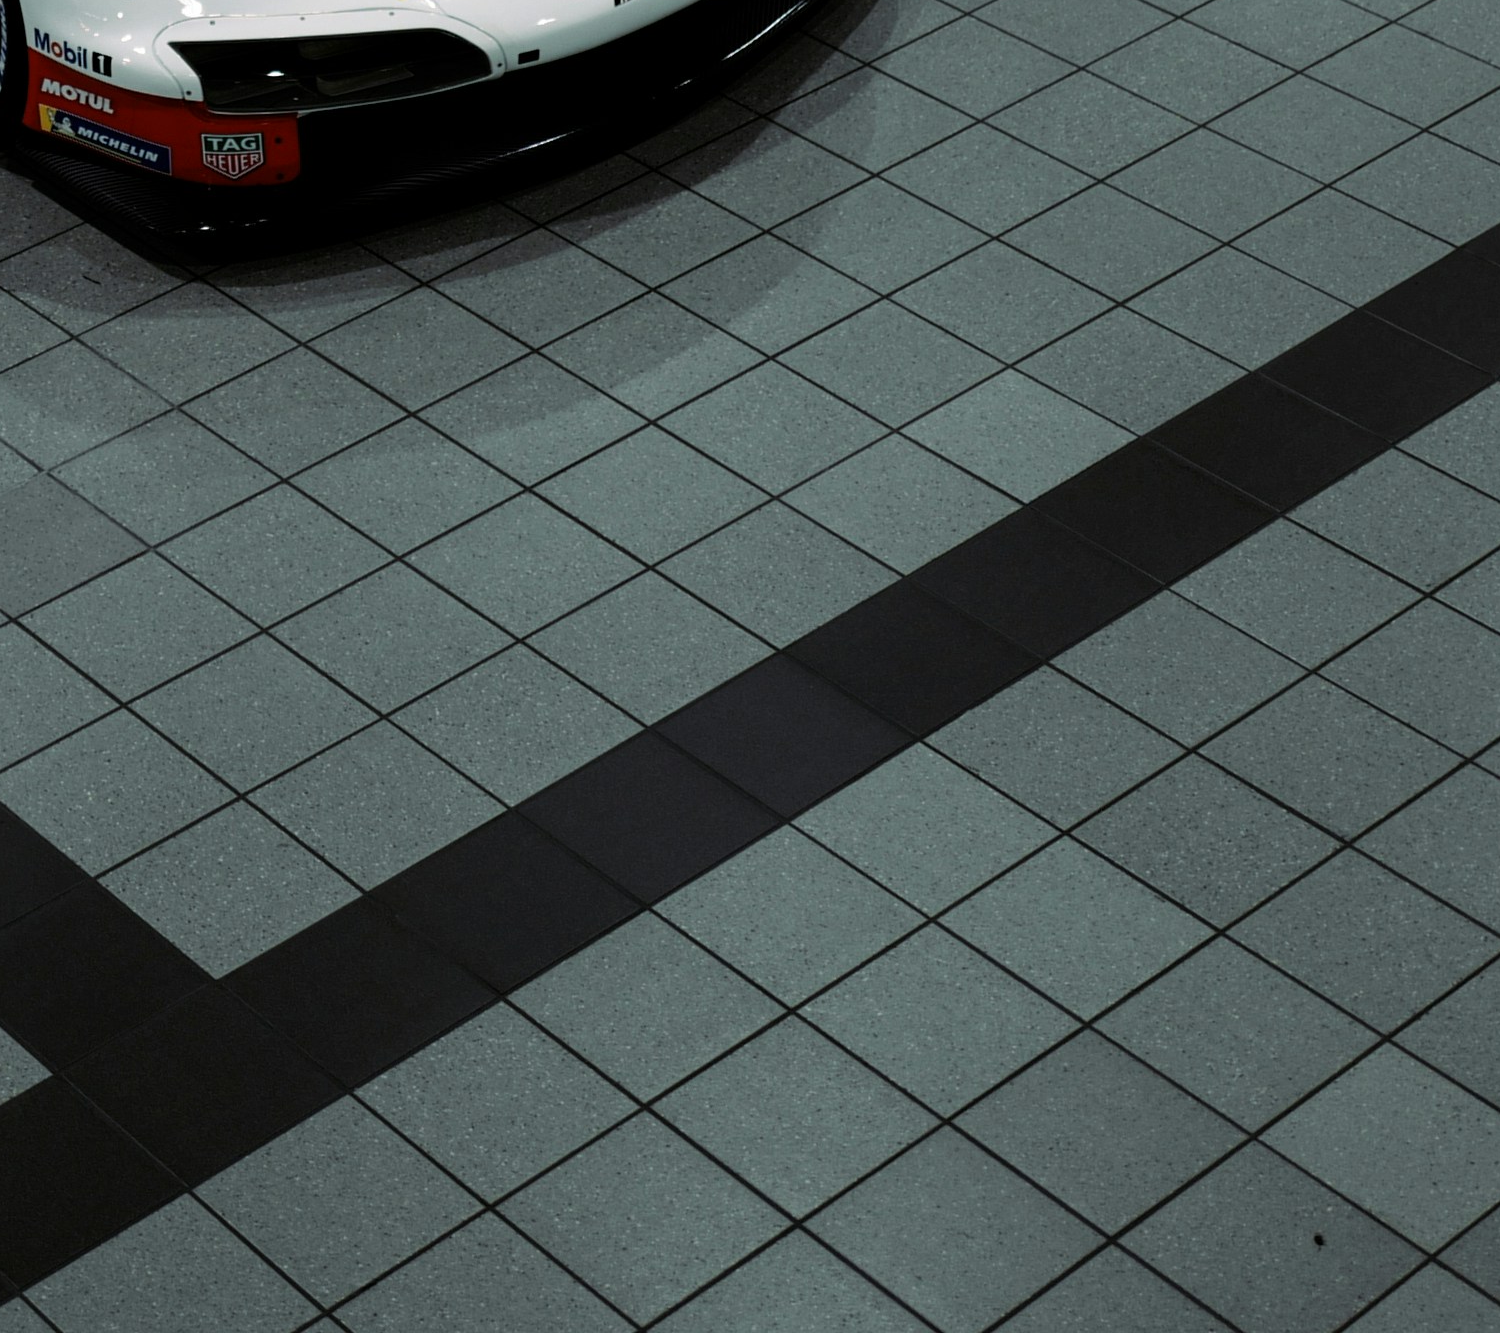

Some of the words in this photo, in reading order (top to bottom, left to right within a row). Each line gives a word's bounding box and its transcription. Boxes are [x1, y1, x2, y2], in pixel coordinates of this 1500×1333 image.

[34, 28, 87, 70] Mobil
[41, 78, 115, 115] MOTUL
[77, 126, 158, 164] MICHELIN
[207, 136, 258, 151] TAG
[206, 153, 262, 176] HEUER
